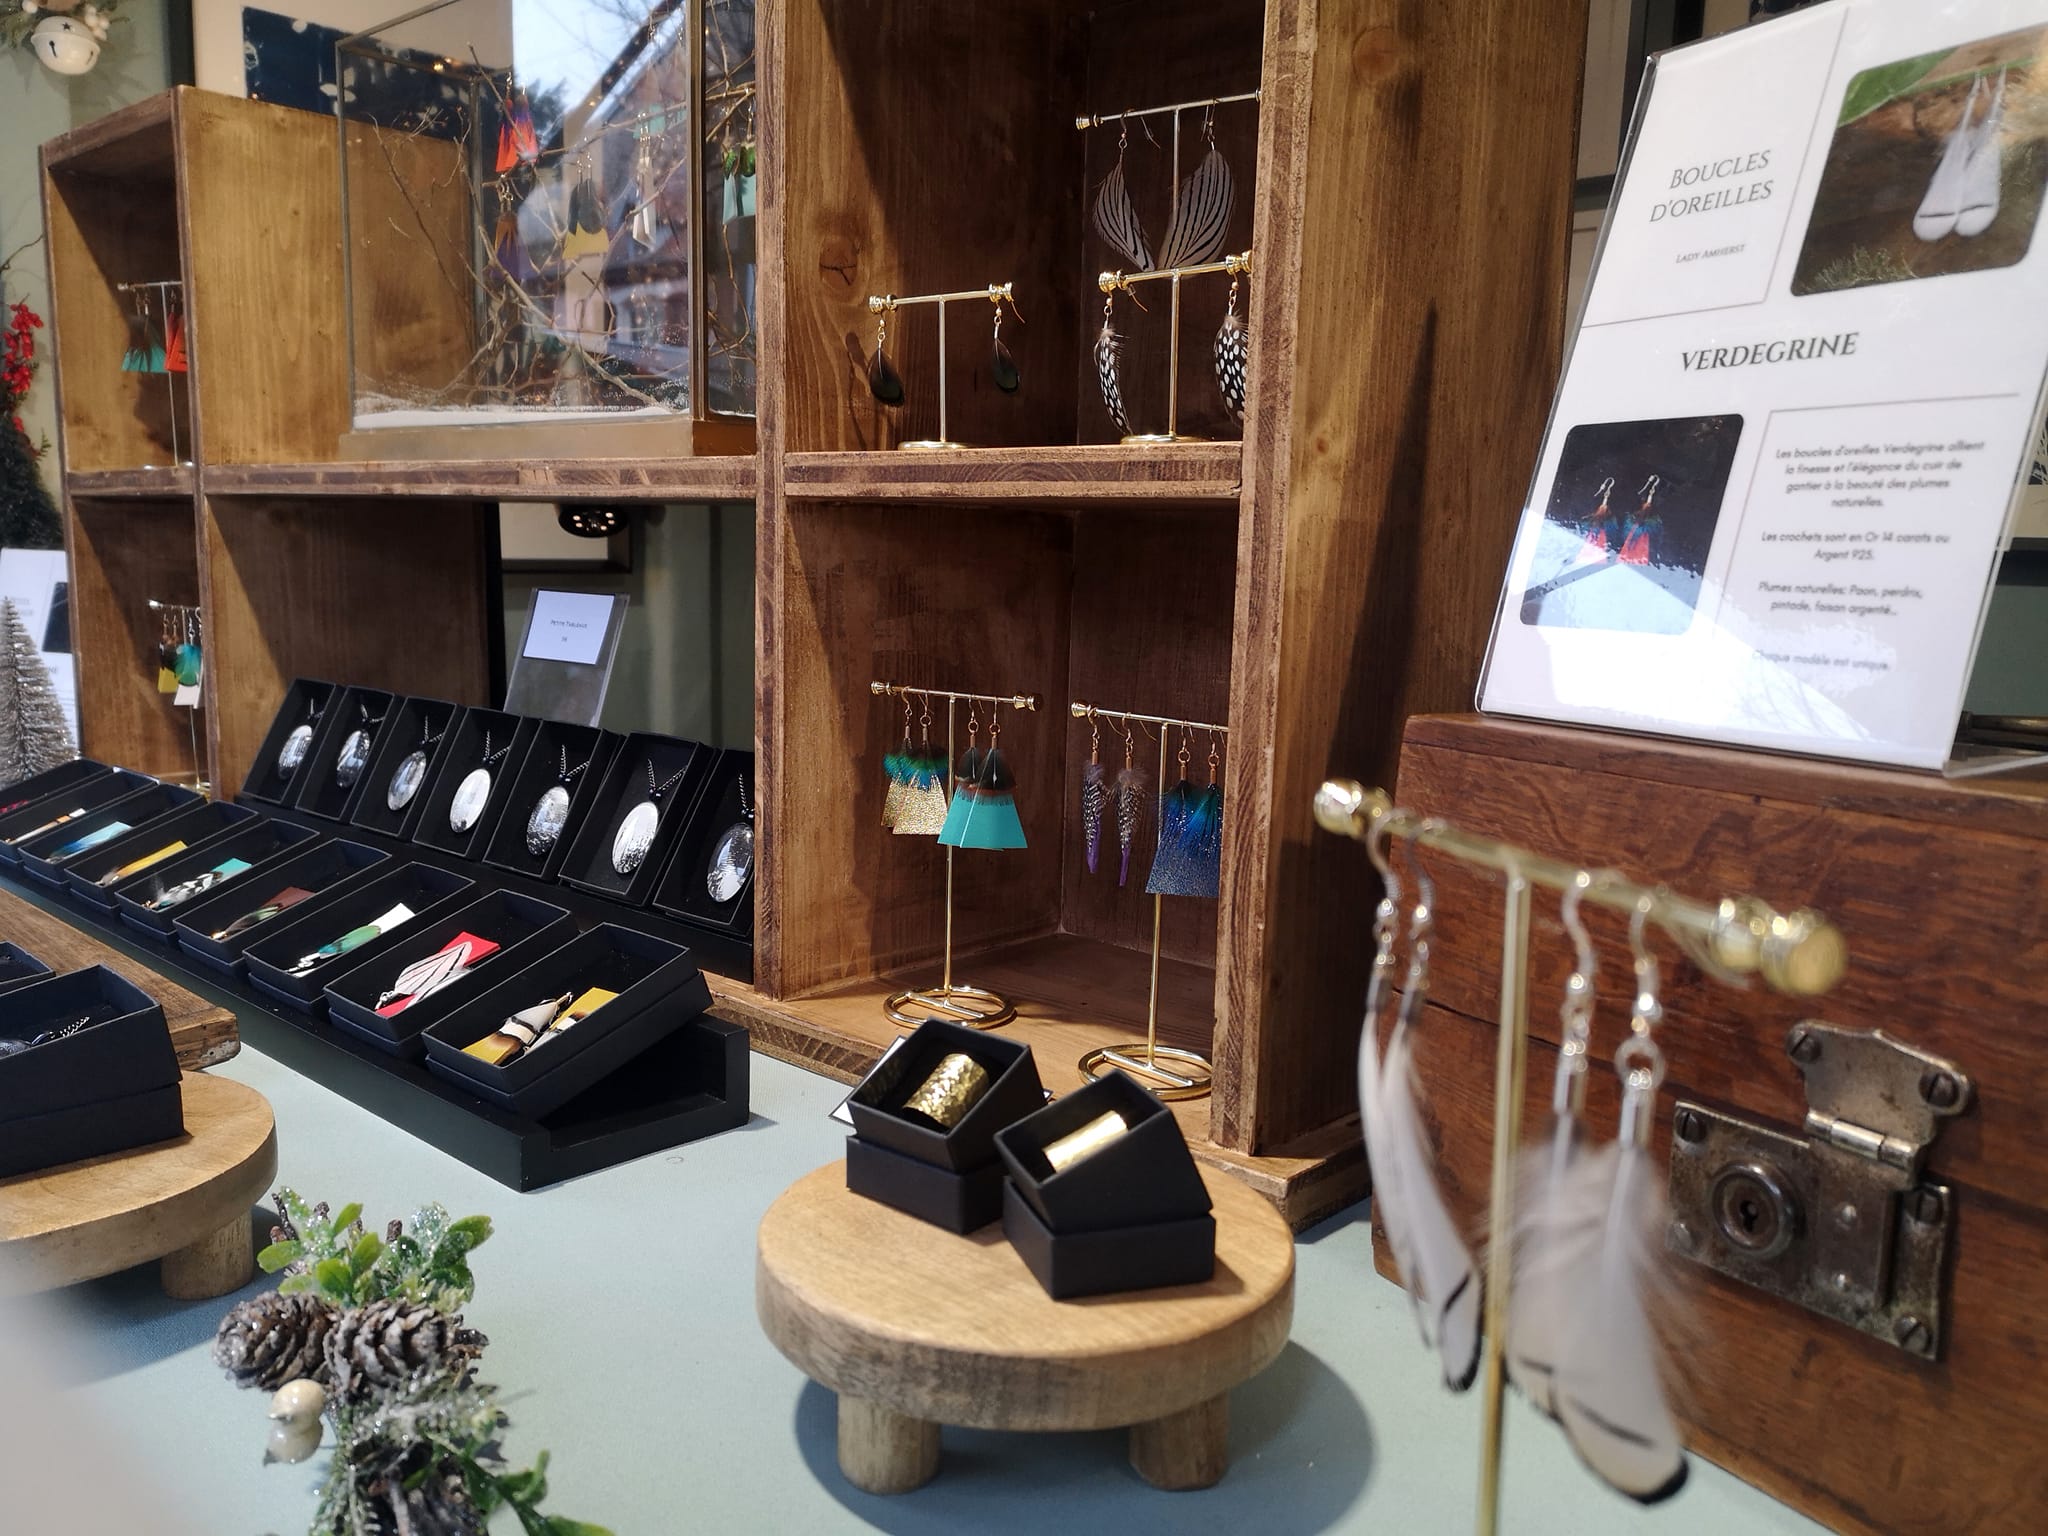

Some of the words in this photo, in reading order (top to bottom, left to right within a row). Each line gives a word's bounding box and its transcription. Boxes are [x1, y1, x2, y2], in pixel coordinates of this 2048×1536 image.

[1669, 149, 1771, 189] BOUCLES
[1649, 179, 1774, 222] D'OREILLES
[1675, 252, 1700, 263] LADY
[1701, 244, 1746, 259] AMHERST
[1681, 332, 1860, 371] VERDEGRINE
[1776, 449, 1792, 459] Les
[1794, 446, 1832, 458] boucles
[1883, 442, 1944, 456] Verdegrine
[1909, 478, 1950, 491] plumes
[1761, 532, 1777, 542] Les
[1779, 532, 1822, 543] crochets
[1824, 532, 1846, 542] sont
[1814, 550, 1849, 562] Argent
[1758, 581, 1793, 592] Plumes
